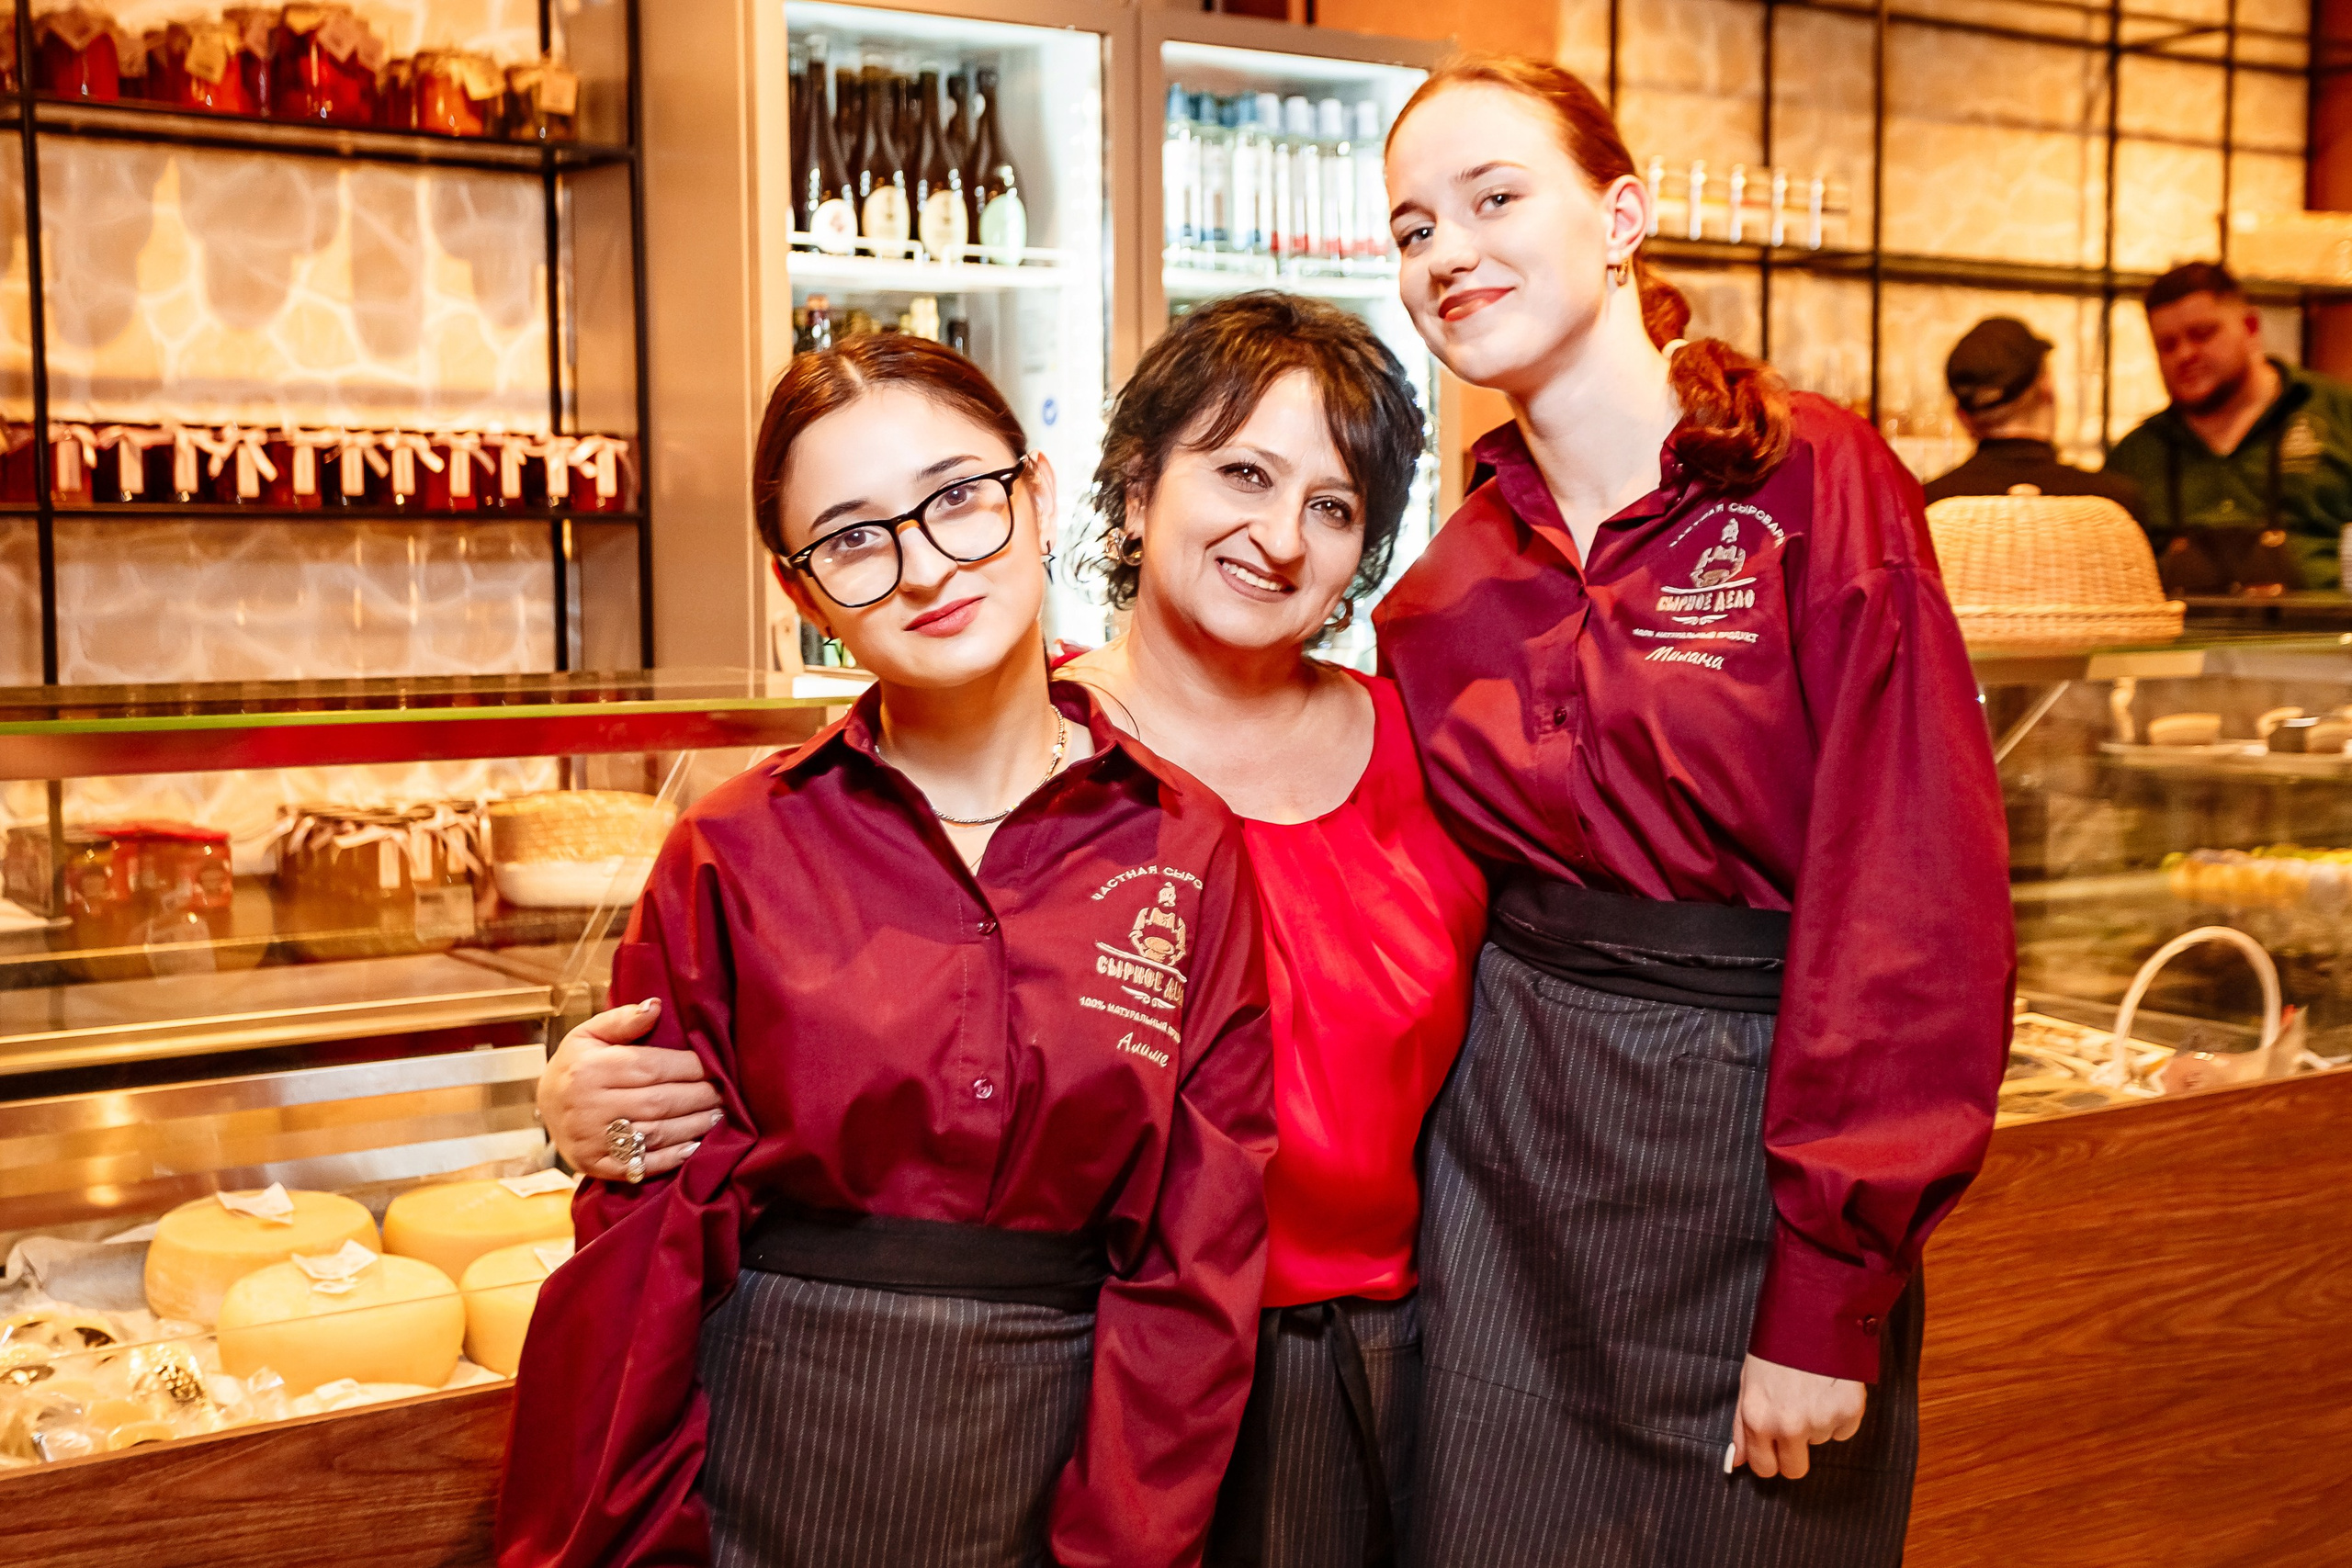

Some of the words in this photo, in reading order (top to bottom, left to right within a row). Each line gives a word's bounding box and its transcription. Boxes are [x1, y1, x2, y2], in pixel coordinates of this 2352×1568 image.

[1656, 592, 1713, 612] СЫРНОЕ
[1713, 589, 1755, 612] ДЕЛО
[1091, 864, 1158, 900] ЧАСТНАЯ
[1096, 954, 1164, 992] СЫРНОЕ
[1079, 996, 1106, 1010] 100%
[1106, 1002, 1168, 1033] НАТУРАЛЬНЫЙ
[1116, 1032, 1170, 1067] Алиме
